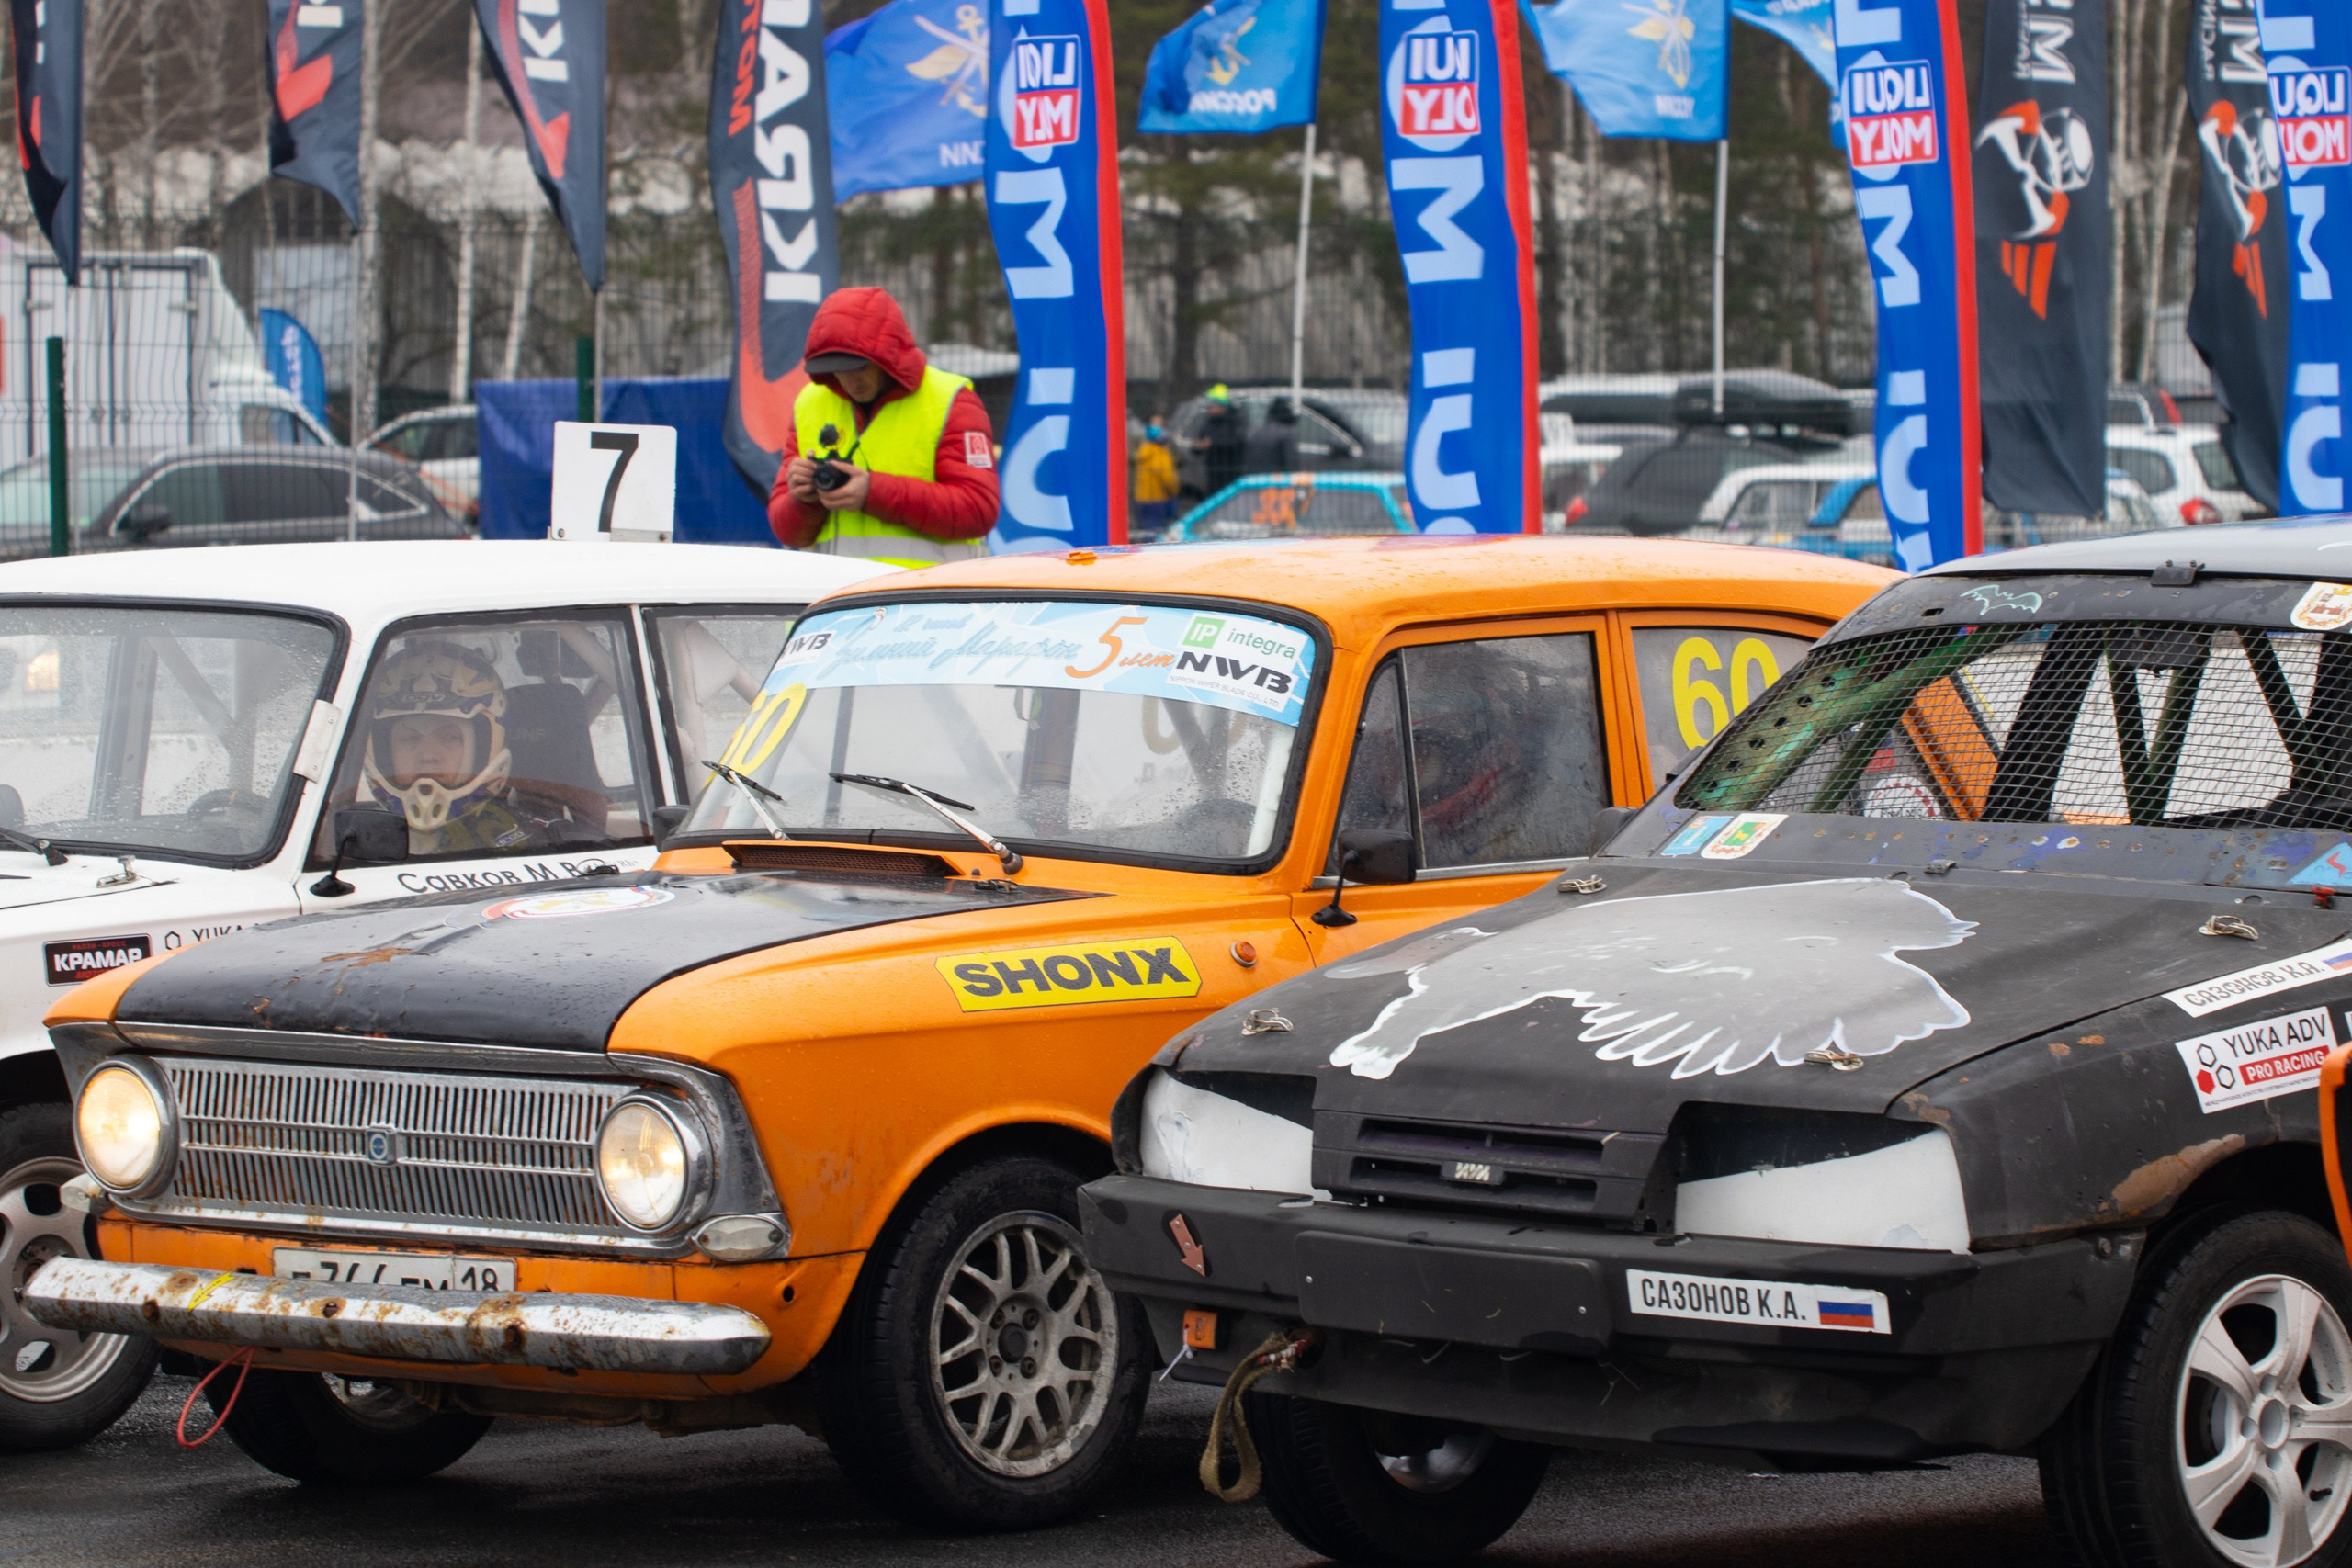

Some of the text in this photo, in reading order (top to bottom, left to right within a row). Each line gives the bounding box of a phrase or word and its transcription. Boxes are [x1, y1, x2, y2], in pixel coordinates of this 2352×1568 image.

[590, 432, 639, 533] 7
[1065, 616, 1148, 678] 5
[1227, 628, 1296, 660] integra
[1170, 675, 1195, 684] NIPPON
[1197, 679, 1220, 688] WIPER
[1221, 682, 1246, 695] BLADE
[1176, 650, 1292, 694] NWB
[53, 948, 143, 972] КРАМАР
[954, 947, 1192, 998] SHONX
[2183, 961, 2325, 1007] САЗОНОВ К.А.
[2222, 1013, 2326, 1058] YUKA ADV
[2245, 1050, 2326, 1082] PRO RACING
[1641, 1278, 1806, 1321] САЗОНОВ К.А.
